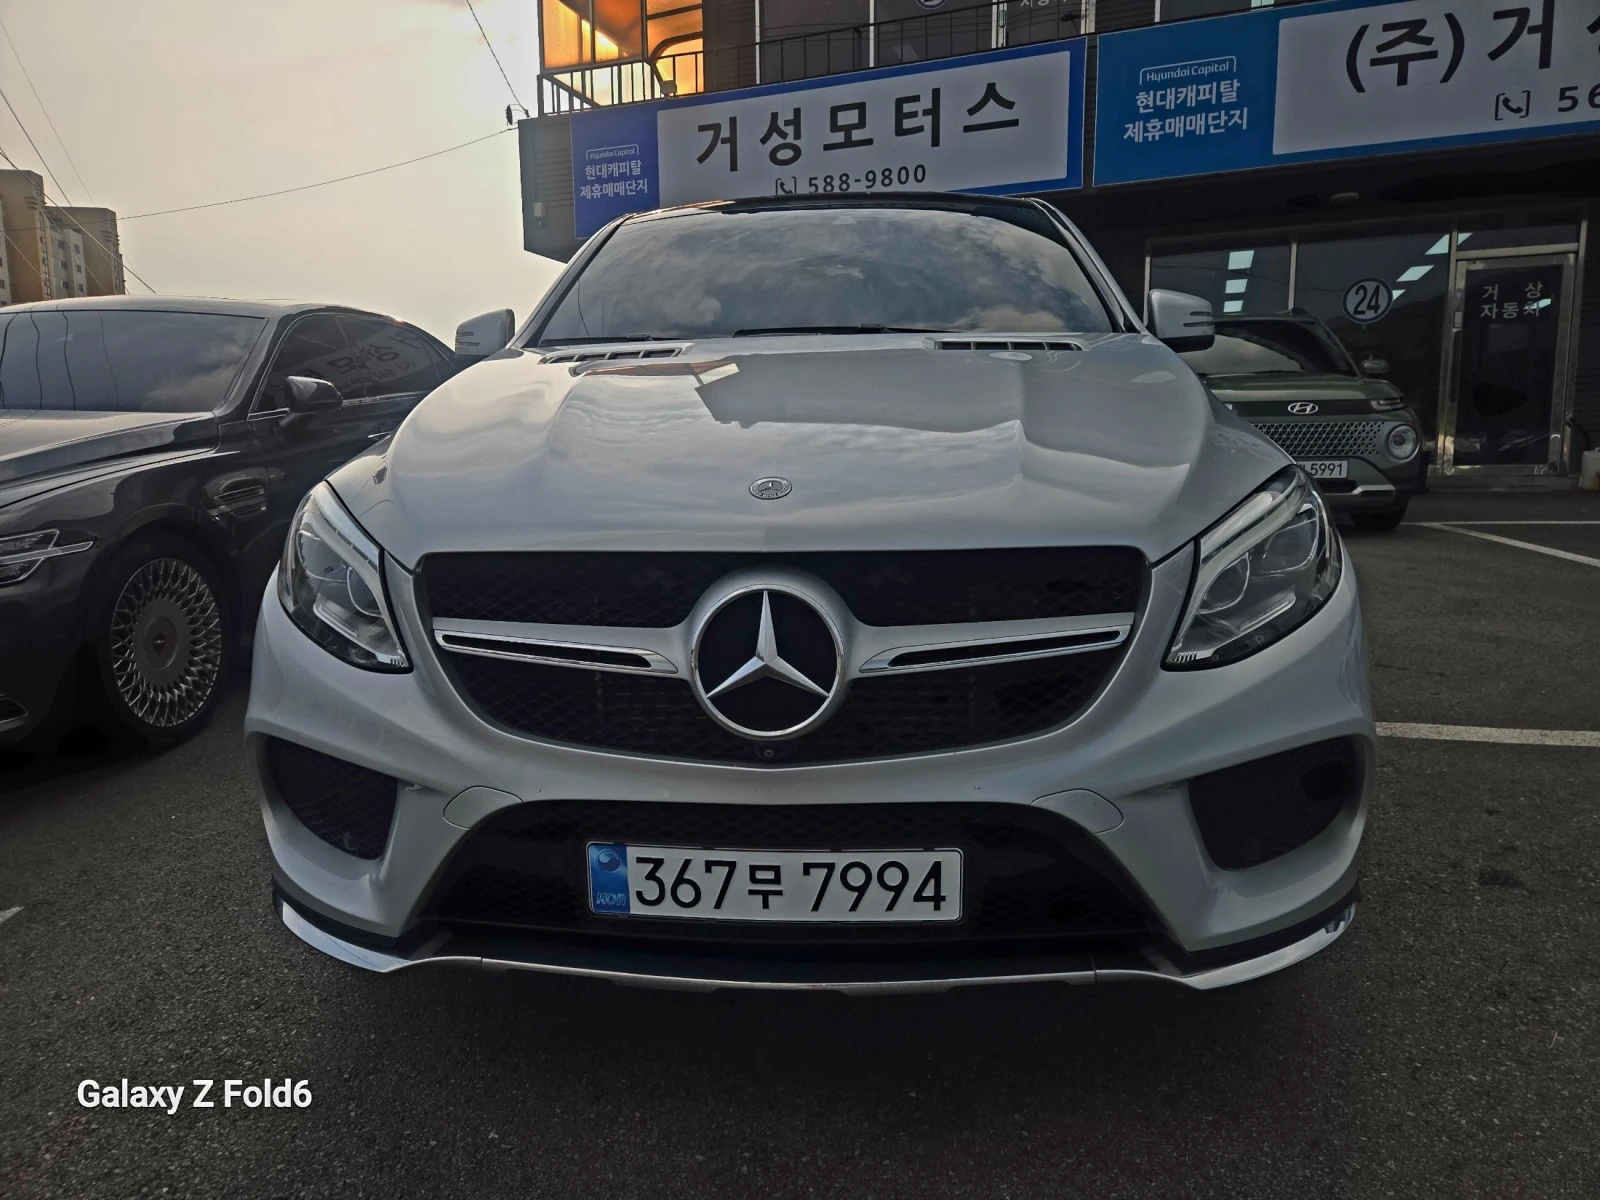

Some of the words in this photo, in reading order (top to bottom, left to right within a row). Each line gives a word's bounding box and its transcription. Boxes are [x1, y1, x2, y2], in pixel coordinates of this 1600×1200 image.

[1346, 0, 1600, 93] (주)거
[1146, 66, 1190, 82] Hyundai
[1192, 61, 1229, 76] Capital
[1136, 79, 1240, 113] 현대캐피탈
[696, 81, 1020, 172] 거성모터스
[1123, 107, 1248, 143] 제휴매매단지
[589, 150, 614, 160] Hyundai
[614, 148, 635, 157] Capital
[585, 160, 642, 180] 현대캐피탈
[808, 164, 926, 193] 588-9800
[580, 178, 648, 200] 제휴매매단지
[1354, 284, 1381, 316] 24
[1310, 463, 1343, 476] 5991
[596, 892, 626, 906] KOR
[802, 860, 946, 912] 7994
